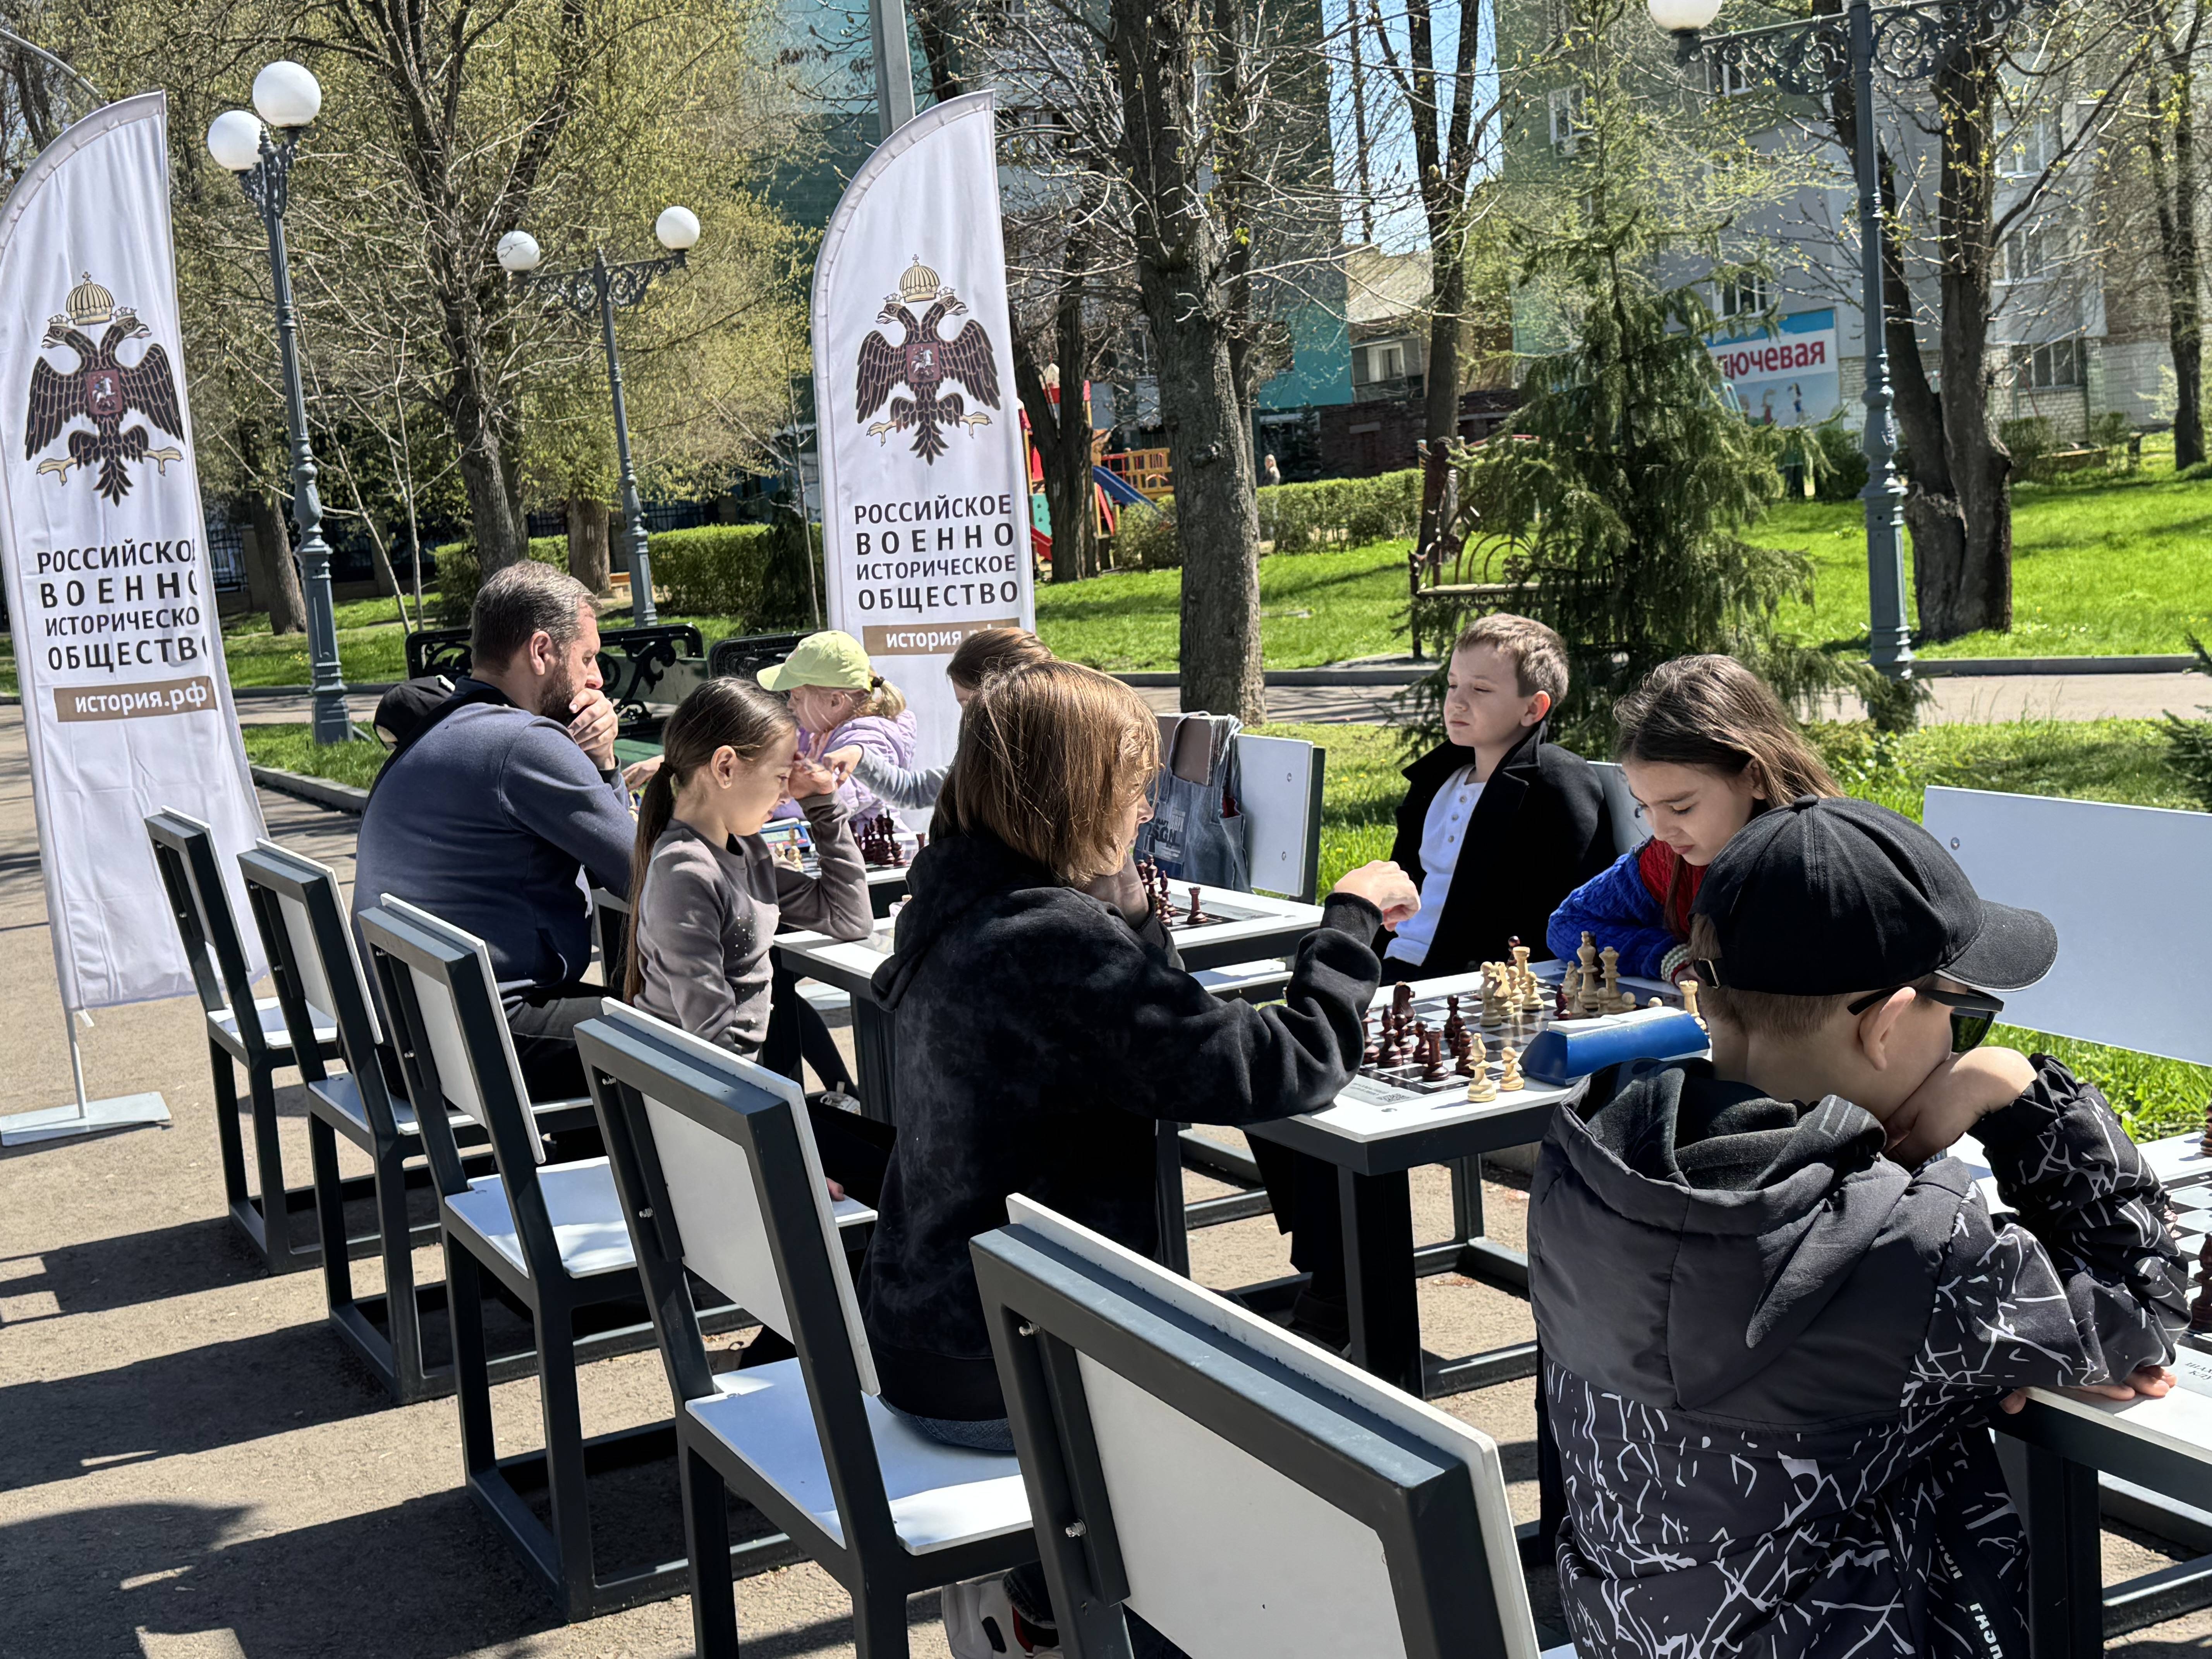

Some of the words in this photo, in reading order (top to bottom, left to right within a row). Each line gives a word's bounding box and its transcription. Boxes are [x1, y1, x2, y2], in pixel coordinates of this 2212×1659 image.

[855, 494, 1012, 524] РОССИЙСКОЕ
[857, 523, 1013, 555] ВОЕННО
[37, 538, 195, 574] РОССИЙСКО
[857, 554, 1016, 580] ИСТОРИЧЕСКОЕ
[859, 581, 1017, 613] ОБЩЕСТВО
[886, 623, 991, 652] история
[48, 636, 207, 673] ОБЩЕСТВ
[75, 681, 207, 715] история.рф
